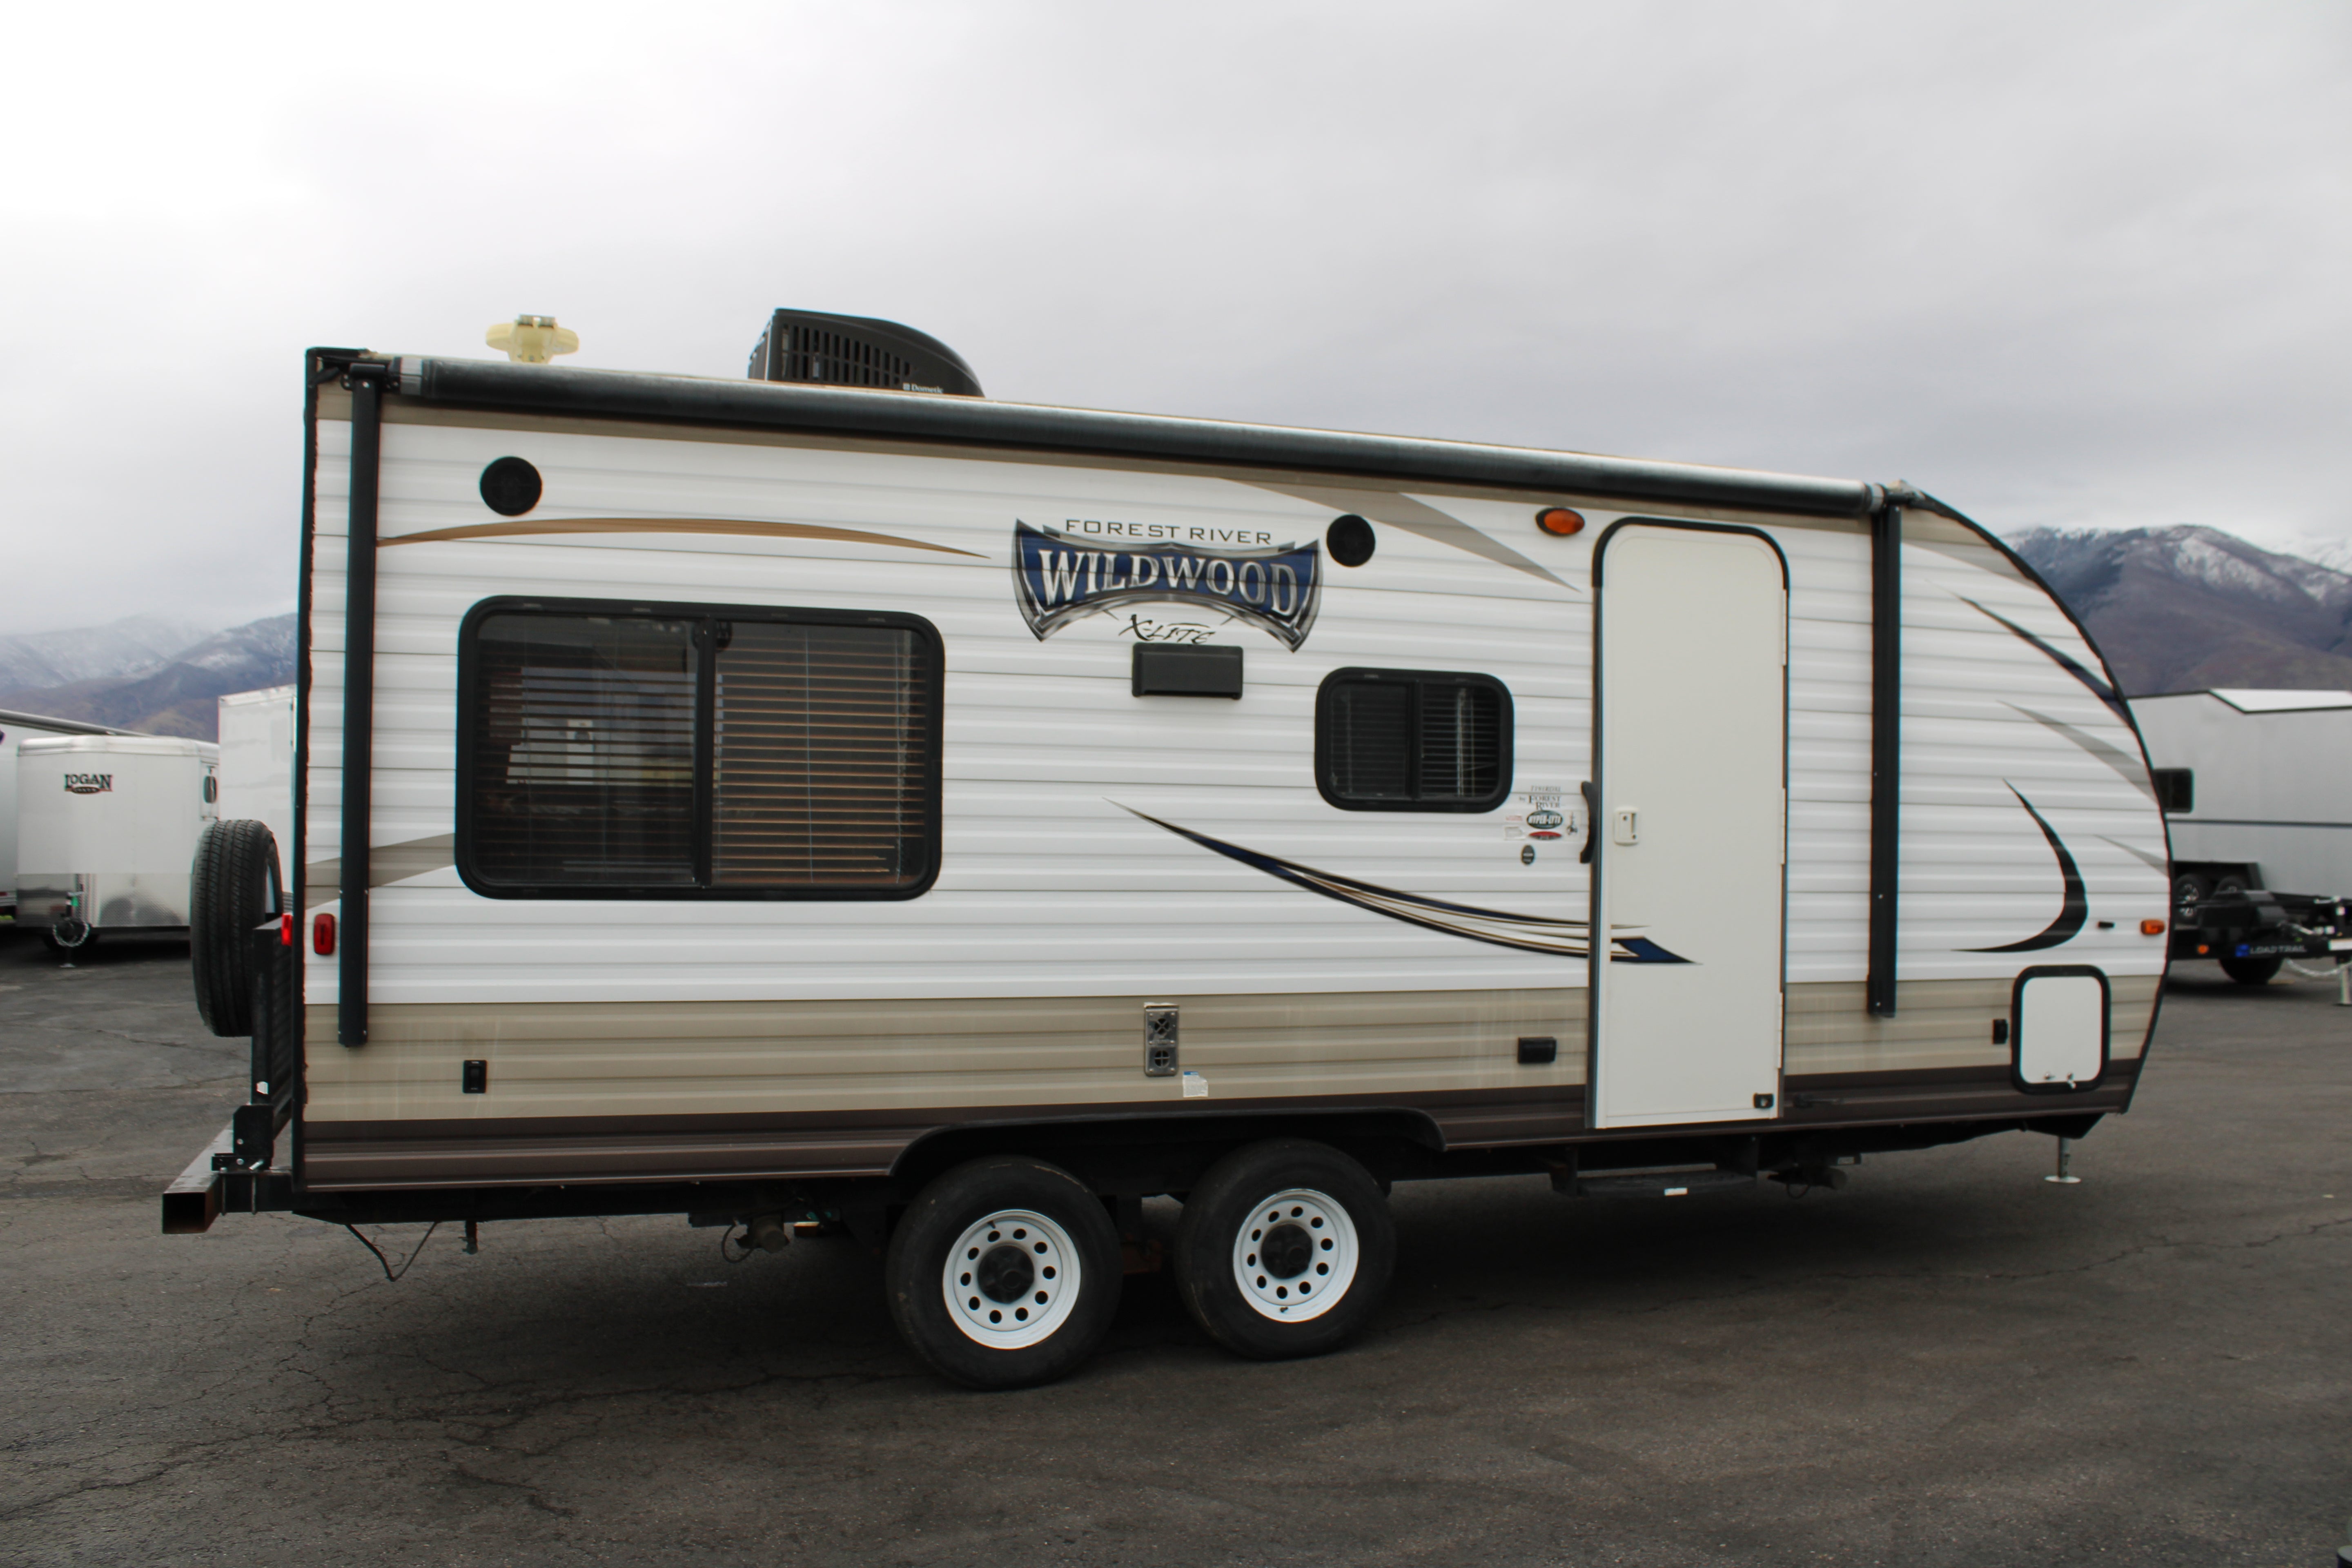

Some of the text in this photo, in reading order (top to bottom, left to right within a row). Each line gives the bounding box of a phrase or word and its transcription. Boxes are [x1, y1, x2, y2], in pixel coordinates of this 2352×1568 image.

[1066, 519, 1271, 545] FOREST RIVER
[1038, 550, 1298, 617] WILDWOOD
[1118, 614, 1216, 644] X-LITE
[64, 774, 113, 790] LOGAN
[1528, 795, 1561, 804] FOREST
[1536, 802, 1560, 811] RIVER
[2250, 944, 2308, 954] LOAD TRAIL
